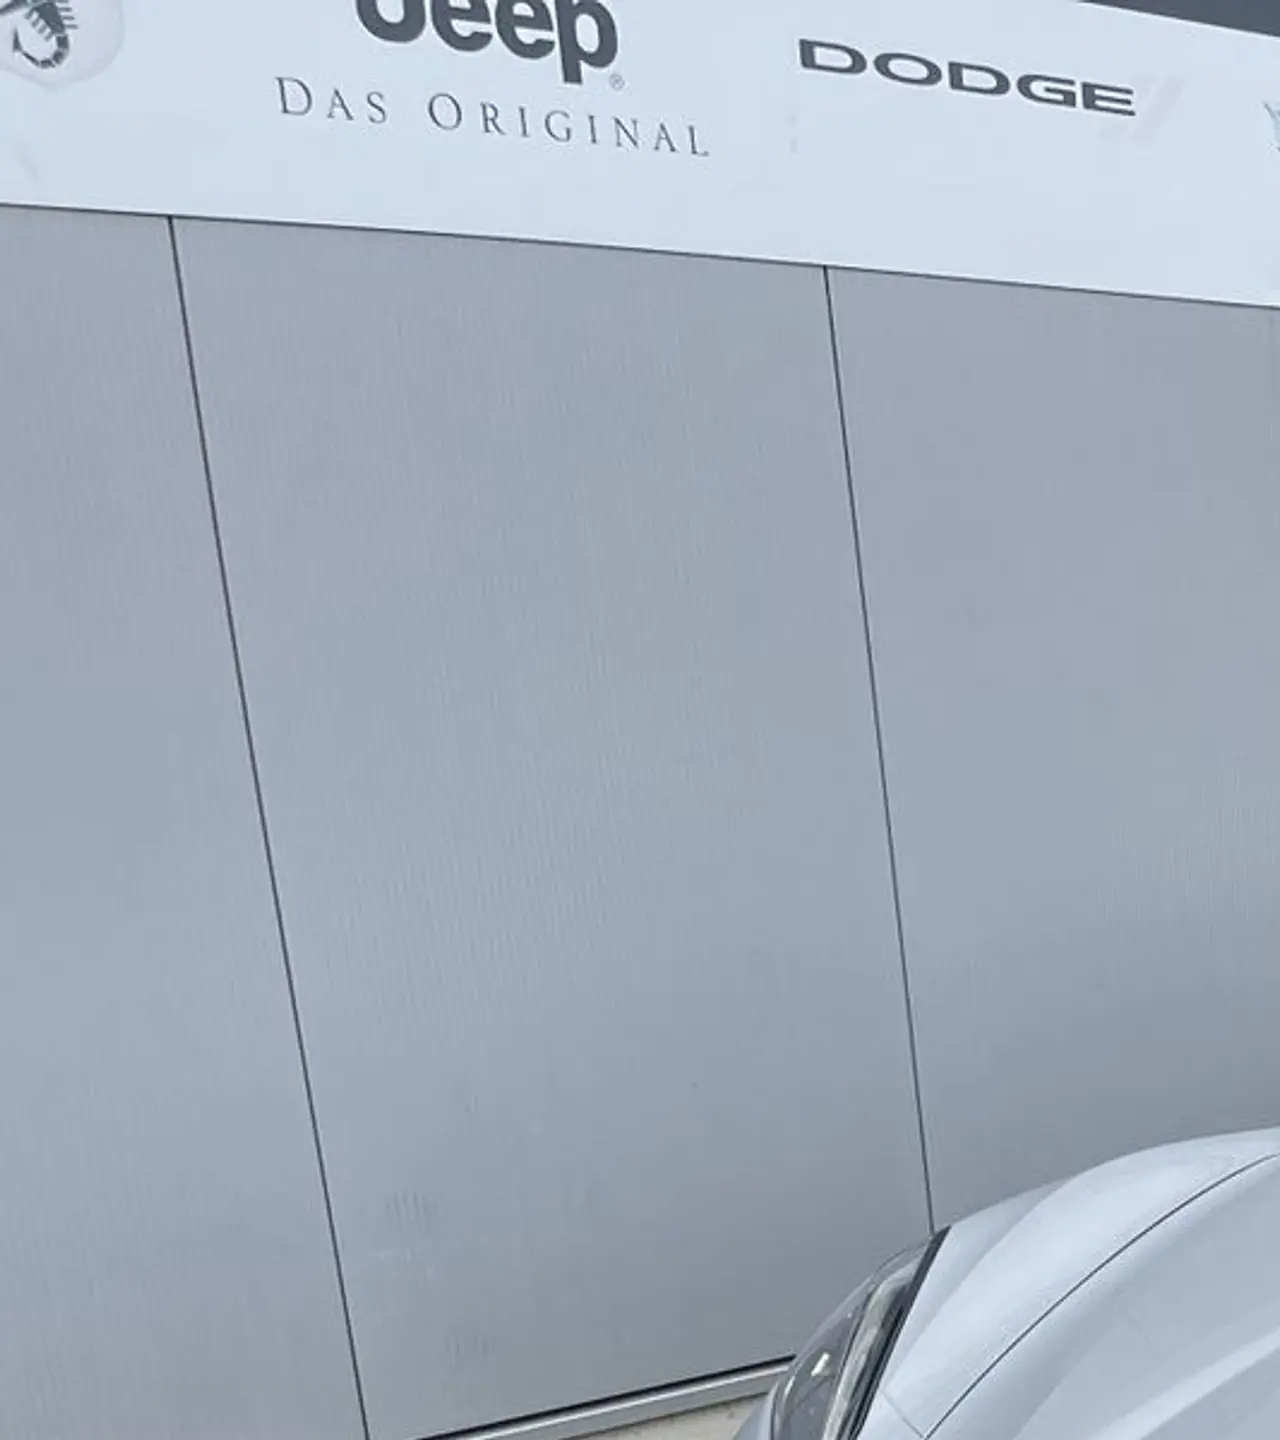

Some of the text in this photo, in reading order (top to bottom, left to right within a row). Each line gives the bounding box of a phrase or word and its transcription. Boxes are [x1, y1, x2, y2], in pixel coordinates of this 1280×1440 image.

[275, 76, 711, 157] DAS ORIGINAL
[798, 38, 1137, 117] DODGE
